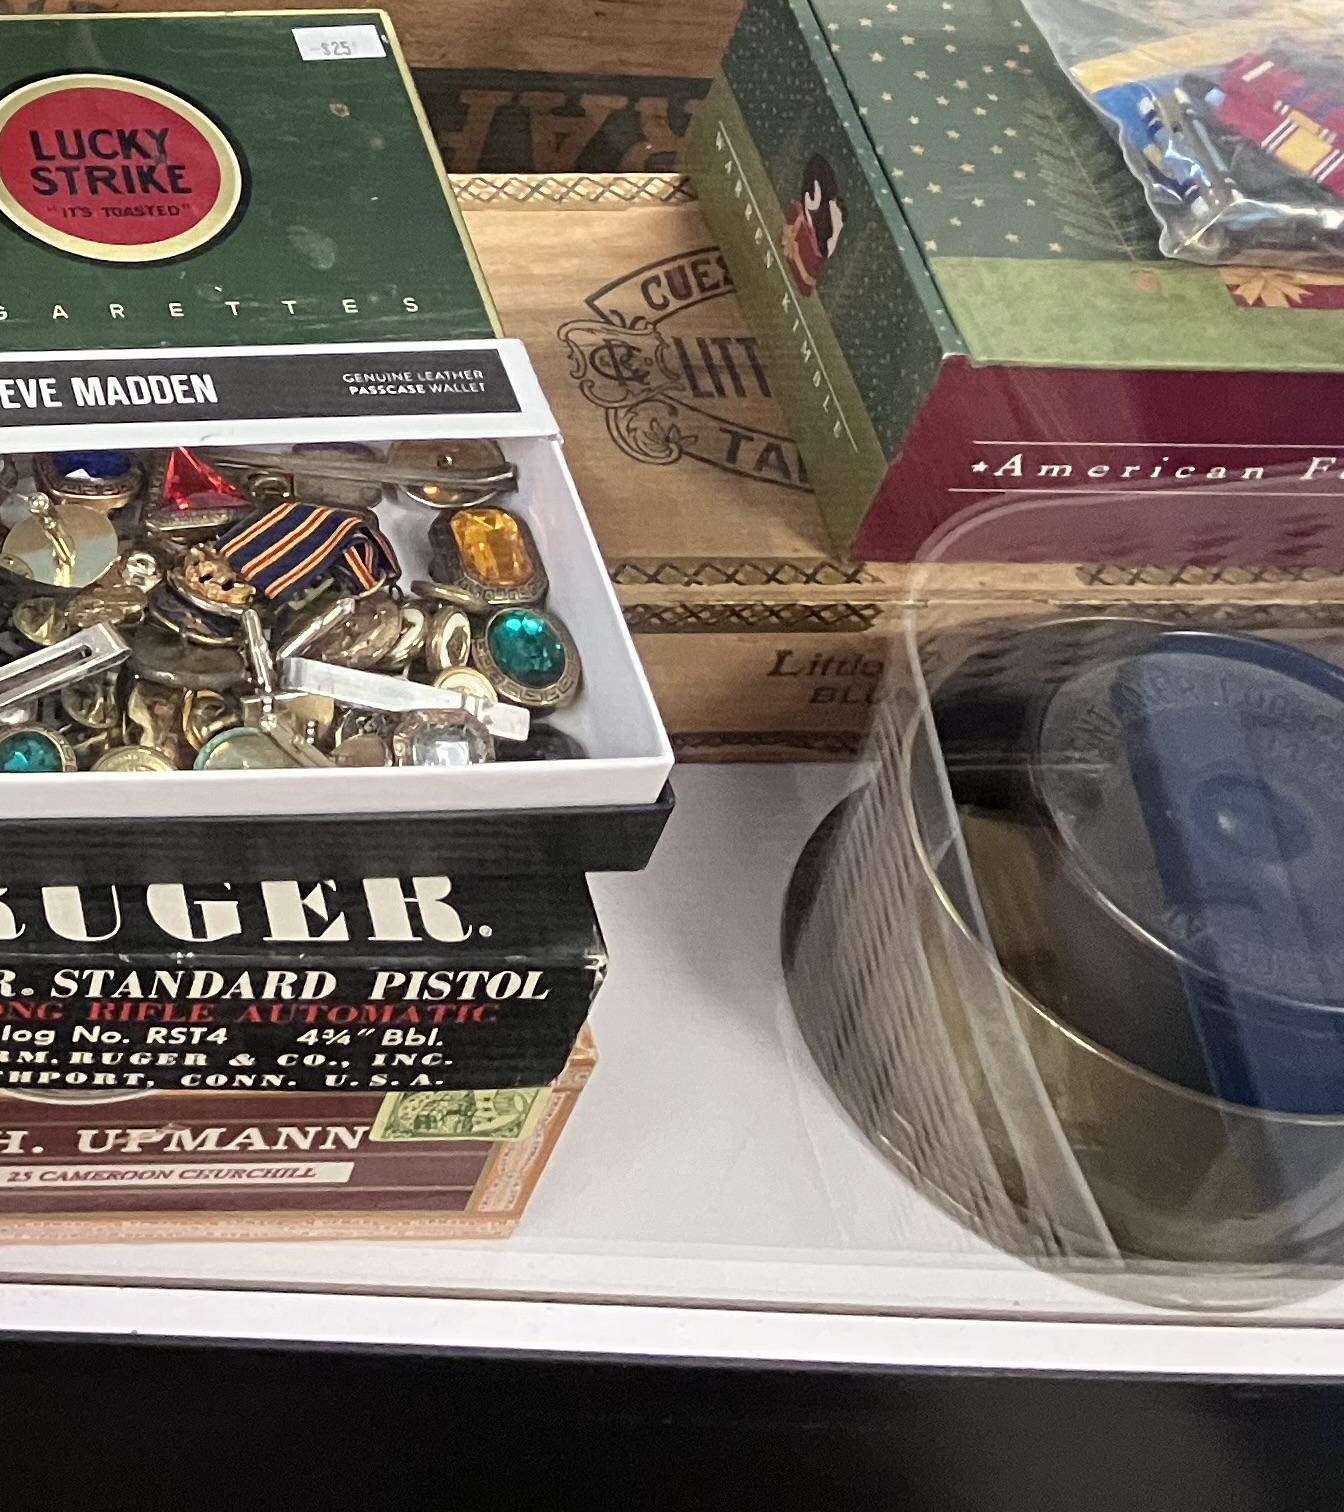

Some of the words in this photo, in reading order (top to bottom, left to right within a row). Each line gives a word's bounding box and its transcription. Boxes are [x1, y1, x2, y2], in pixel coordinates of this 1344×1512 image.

[29, 128, 169, 161] LUCKY
[30, 165, 192, 195] STRIKE
[343, 370, 414, 384] GENUINE
[417, 368, 484, 382] LEATHER
[71, 372, 219, 408] MADDEN
[348, 383, 426, 397] PASSCASE
[428, 382, 487, 394] WALLET
[993, 453, 1267, 481] American
[51, 969, 337, 999] STANDARD
[367, 970, 552, 1001] PISTOL
[88, 1001, 214, 1023] RIFLE
[238, 1002, 499, 1025] AUTOMATIC
[72, 1025, 130, 1045] No.
[146, 1025, 228, 1045] RST4
[381, 1028, 444, 1047] Bbl.
[68, 1051, 208, 1066] RUGER
[229, 1054, 257, 1067] &
[371, 1053, 453, 1067] INC.
[180, 1073, 297, 1087] CONN.
[76, 1126, 372, 1154] UPMANN
[7, 1170, 33, 1183] 25
[39, 1168, 175, 1182] CAMEROON
[178, 1166, 318, 1180] CHURCHILL
